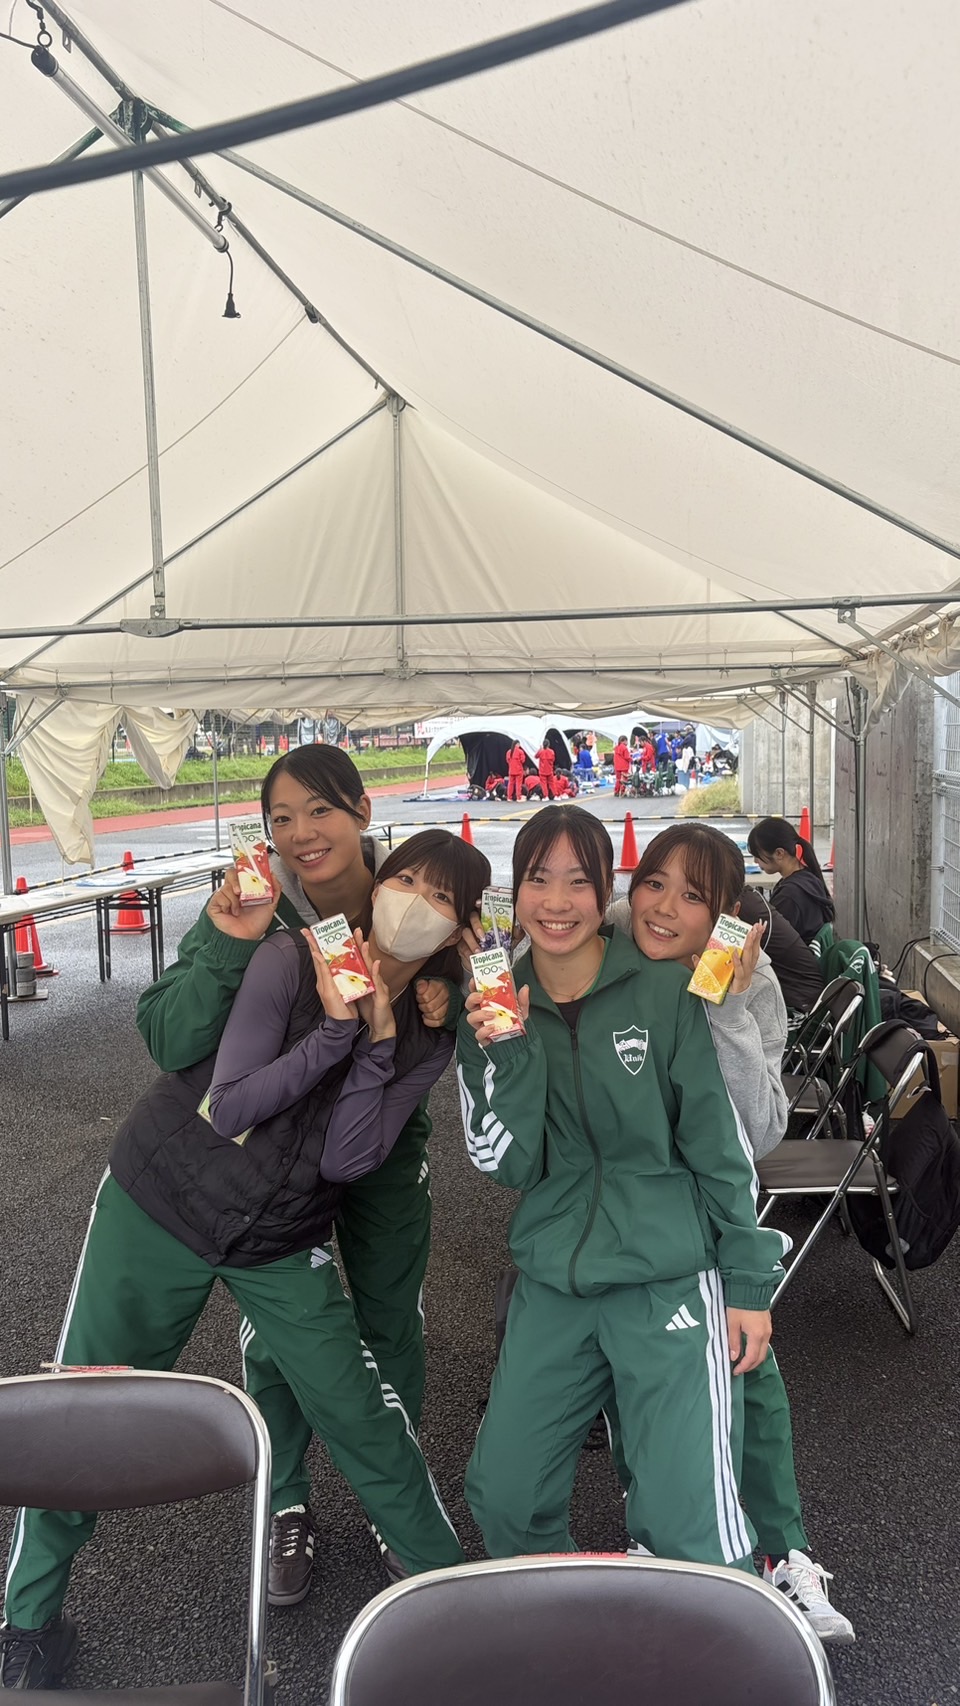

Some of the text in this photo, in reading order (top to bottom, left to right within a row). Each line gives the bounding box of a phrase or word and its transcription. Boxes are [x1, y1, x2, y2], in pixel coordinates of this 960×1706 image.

[484, 892, 513, 904] Tropicana
[312, 918, 346, 935] Tropicana
[719, 915, 749, 935] Tropicana
[323, 931, 348, 945] 100%
[718, 931, 740, 946] 100%
[471, 951, 504, 965] Tropicana
[479, 964, 504, 976] 100%
